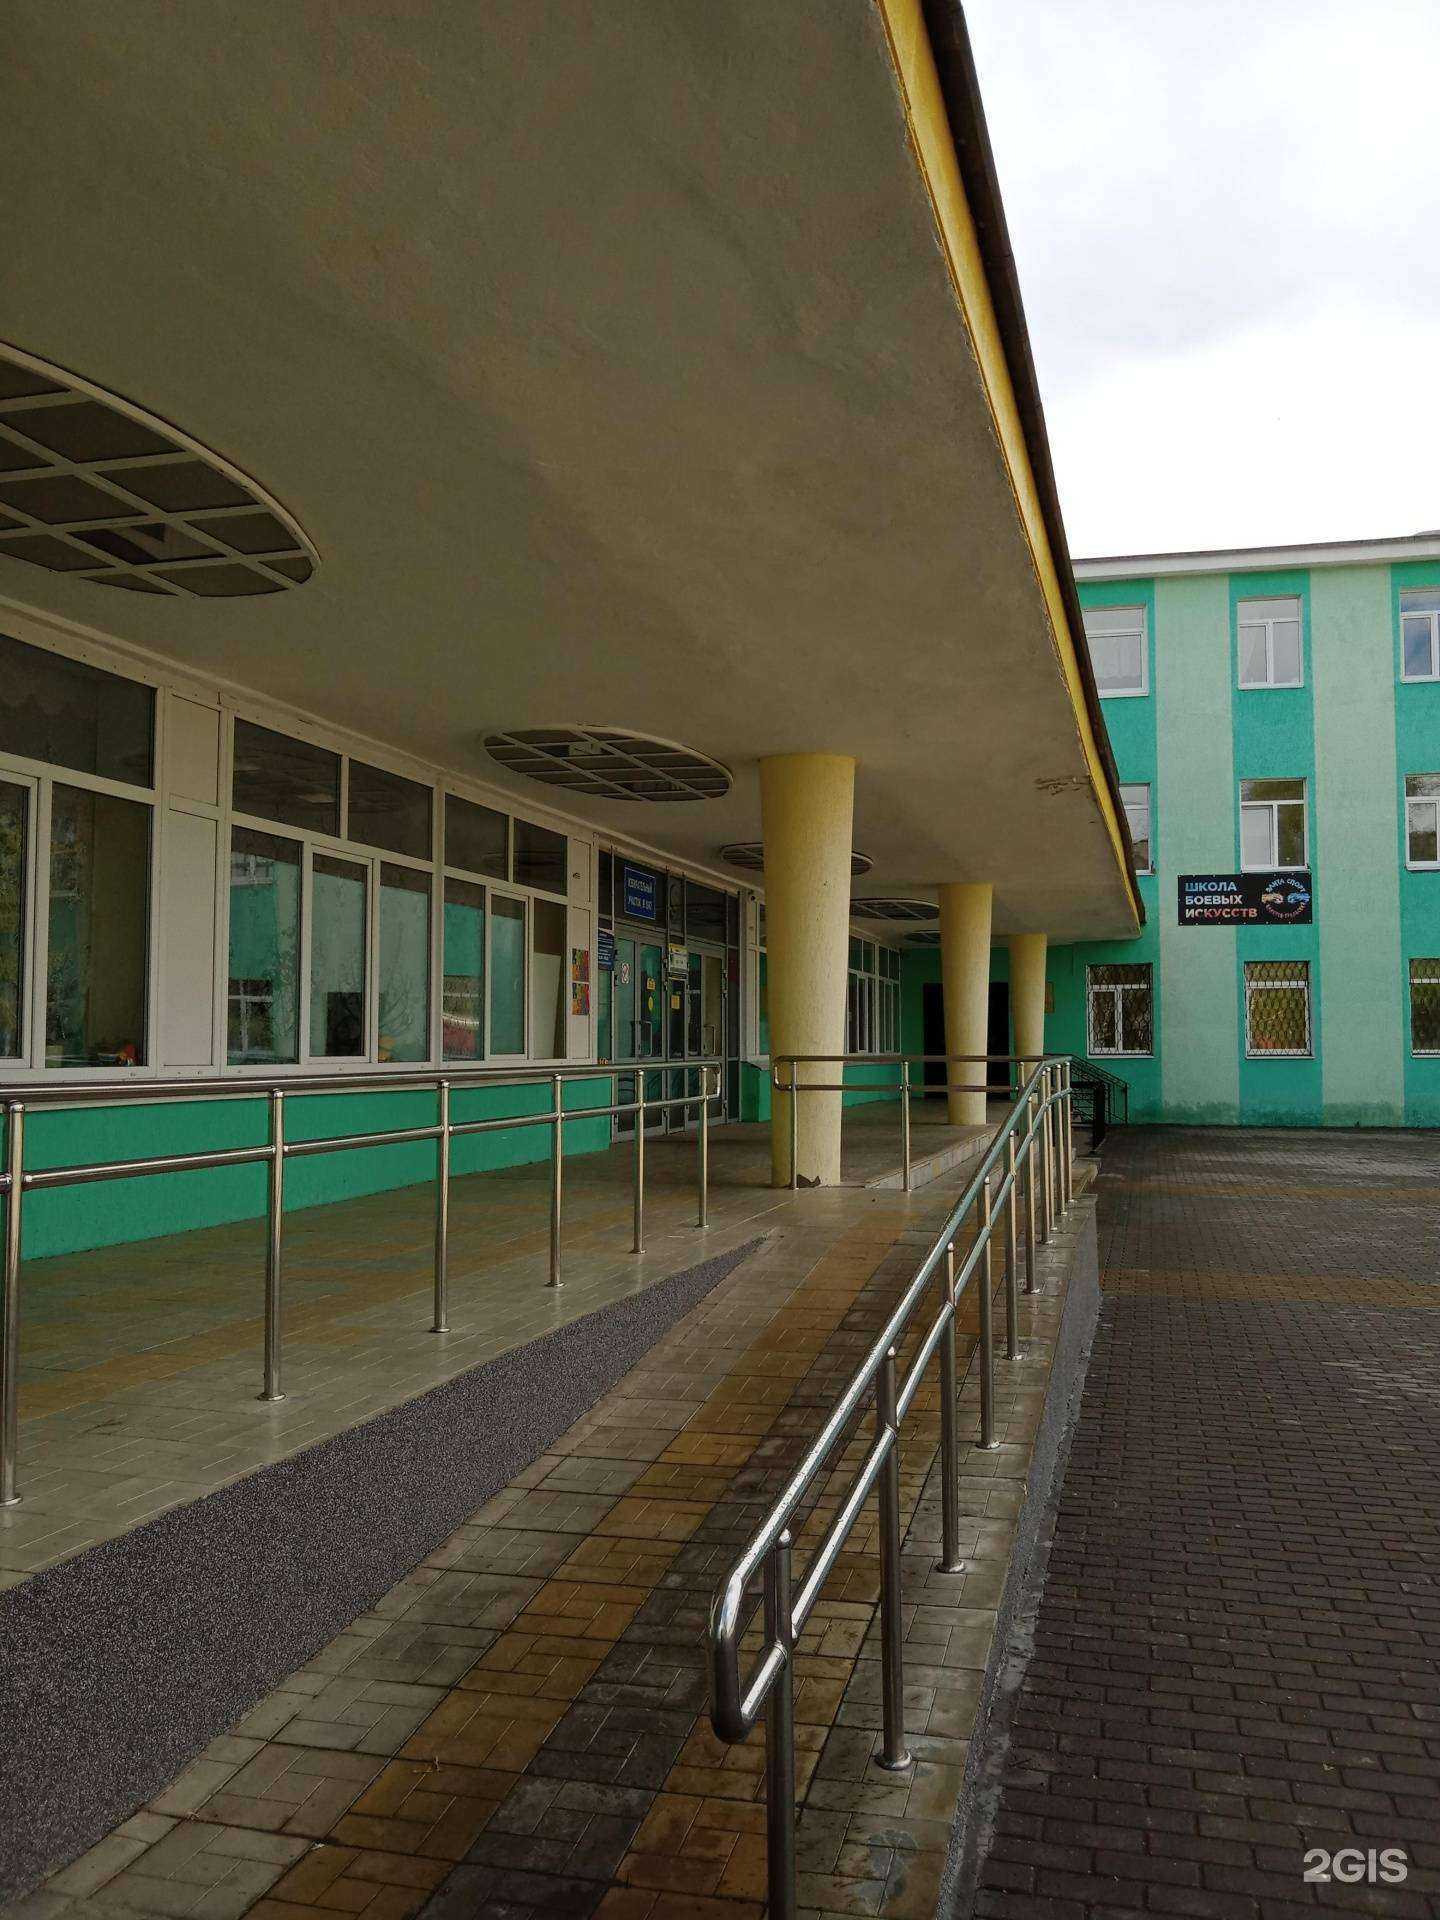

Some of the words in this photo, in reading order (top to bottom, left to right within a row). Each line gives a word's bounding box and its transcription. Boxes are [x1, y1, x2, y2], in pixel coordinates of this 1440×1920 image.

[1185, 881, 1237, 892] ШКОЛА
[1185, 895, 1243, 905] БОЕВЫХ
[1185, 908, 1258, 918] ИСКУССТВ
